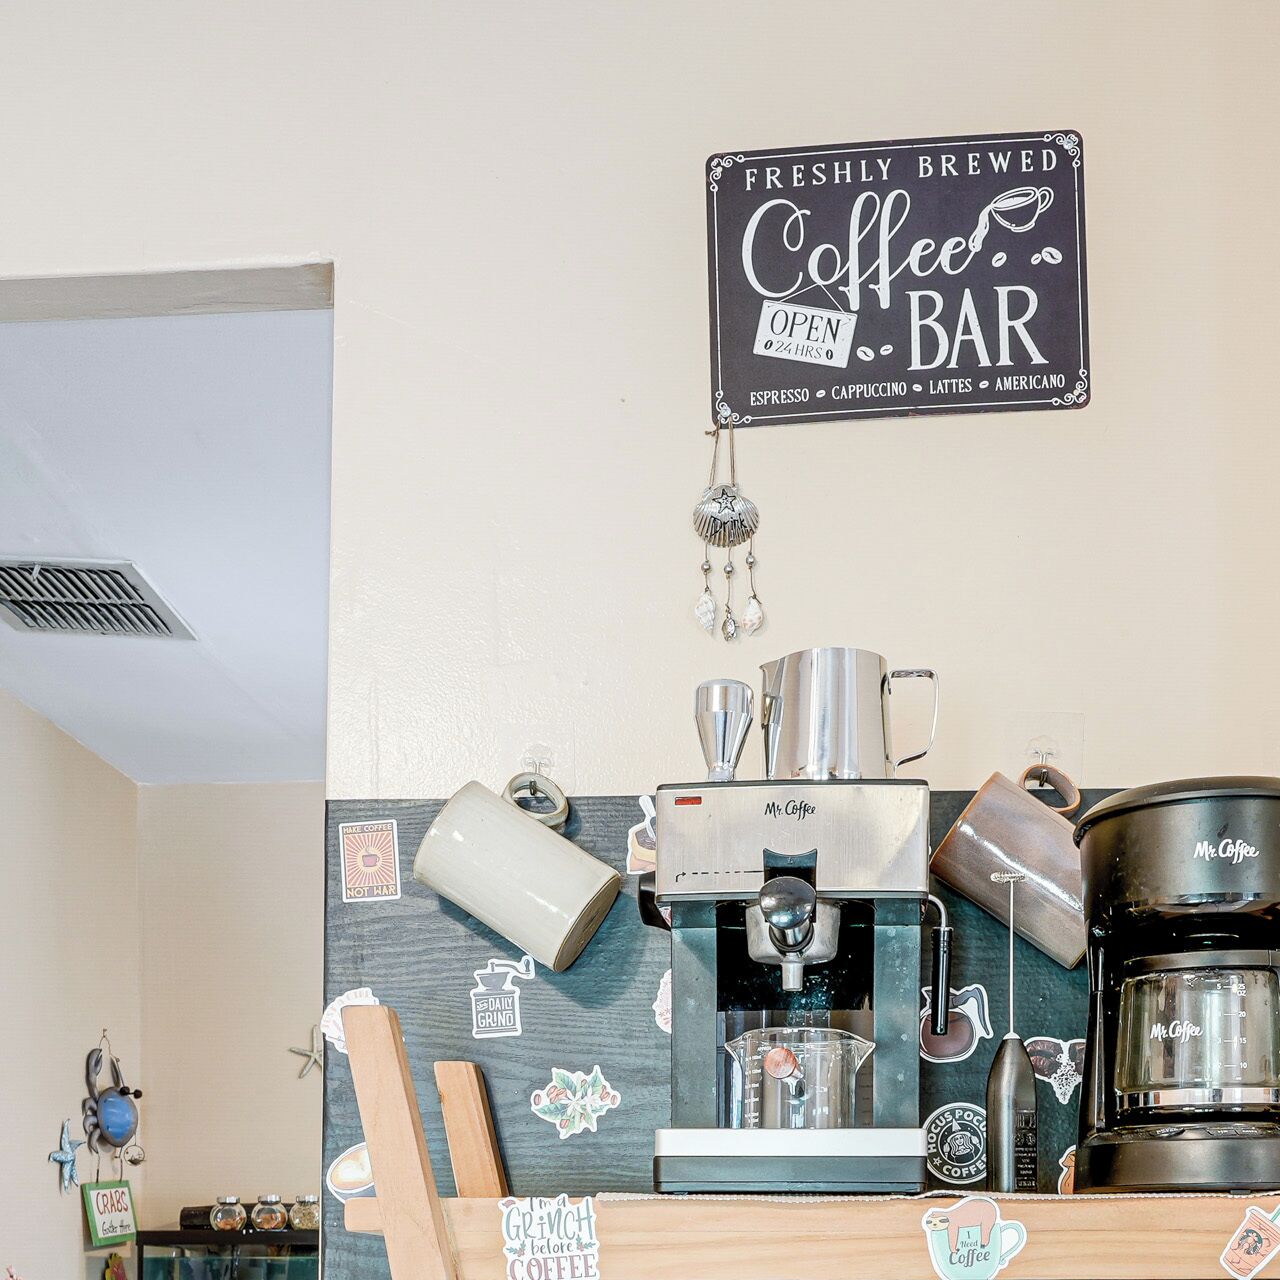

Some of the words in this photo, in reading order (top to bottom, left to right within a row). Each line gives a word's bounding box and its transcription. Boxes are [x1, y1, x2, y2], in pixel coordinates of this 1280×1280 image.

[745, 158, 892, 191] FRESHLY
[919, 149, 1058, 178] BREWED
[742, 190, 976, 311] Coffee
[770, 310, 842, 346] OPEN
[905, 285, 1049, 371] BAR
[775, 340, 795, 356] 24
[794, 343, 823, 360] HRS
[749, 387, 810, 406] ESPRESSO
[831, 381, 908, 401] CAPPUCCINO
[929, 378, 973, 395] LATTES
[995, 373, 1066, 392] AMERICANO
[764, 801, 783, 819] Mr.
[784, 799, 816, 821] Coffee
[343, 825, 362, 834] MAKE
[363, 823, 393, 832] COFFEE
[1193, 841, 1218, 862] Mr.
[1218, 838, 1260, 864] Coffee
[346, 886, 369, 898] NOT
[373, 885, 396, 896] WAR
[488, 996, 513, 1011] DAILY
[477, 1010, 514, 1028] GRIND
[1150, 1022, 1169, 1042] Mr.
[1168, 1020, 1204, 1043] Coffee
[927, 1111, 953, 1154] HOCUS
[95, 1189, 129, 1216] CRABS
[557, 1196, 567, 1208] a
[959, 1240, 979, 1249] Need
[966, 1230, 971, 1240] I
[531, 1238, 574, 1256] before
[948, 1248, 991, 1268] Coffee
